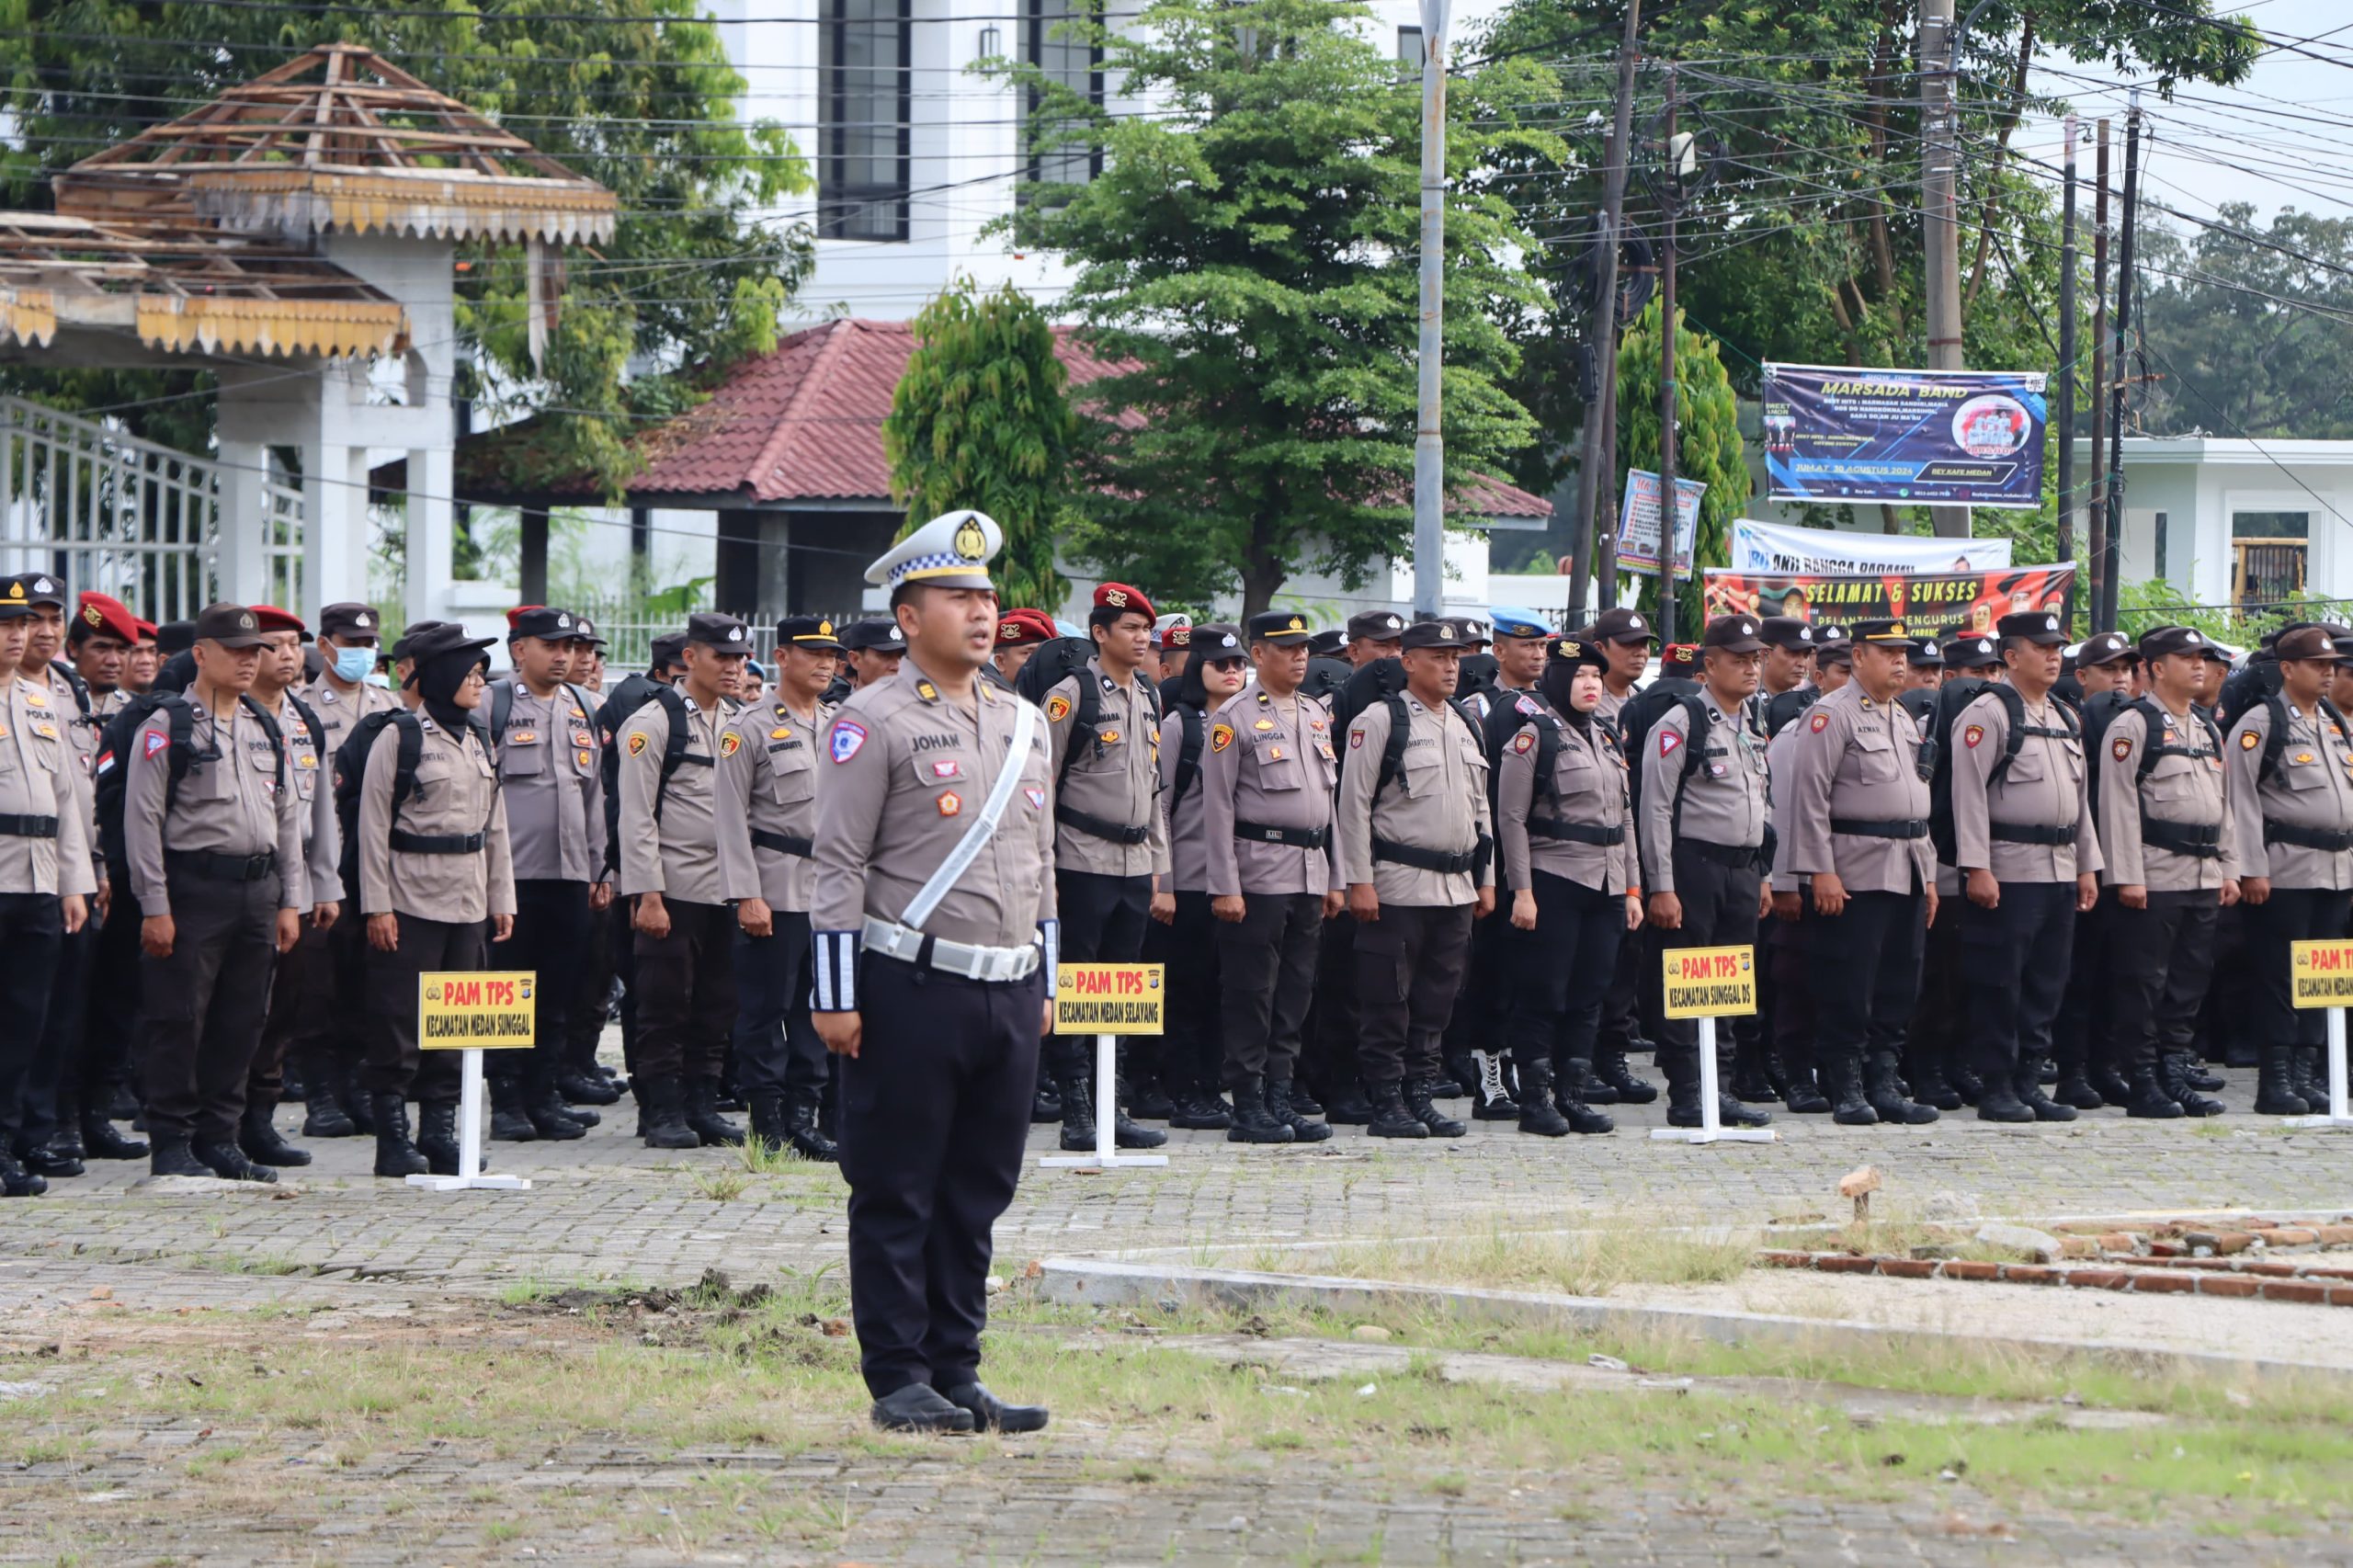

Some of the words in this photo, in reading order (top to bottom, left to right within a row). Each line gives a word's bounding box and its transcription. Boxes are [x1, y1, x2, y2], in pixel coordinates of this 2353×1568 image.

[1821, 381, 1910, 397] MARSADA
[1918, 385, 1969, 399] BAND
[1846, 464, 1889, 475] AGUSTUS
[1805, 583, 1883, 603] SELAMAT
[1891, 582, 1904, 603] &
[1911, 581, 1978, 603] SUKSES
[25, 710, 55, 722] POLRI
[568, 718, 590, 729] POL
[248, 741, 274, 751] POL
[291, 736, 313, 746] POL
[911, 733, 961, 753] JOHAN
[1253, 732, 1286, 744] LINGGA
[1682, 956, 1711, 980] PAM
[1714, 954, 1737, 978] TPS
[2311, 949, 2341, 971] PAM
[2344, 948, 2353, 970] T
[1076, 971, 1112, 994] PAM
[1115, 971, 1143, 994] TPS
[2298, 977, 2333, 998] KECAMATAN
[444, 981, 481, 1006] PAM
[485, 981, 515, 1006] TPS
[1669, 985, 1710, 1008] KECAMATAN
[1710, 983, 1741, 1006] SUNGGAL
[1742, 983, 1751, 1004] DS
[1059, 1001, 1099, 1024] KECAMATAN
[1100, 1002, 1124, 1024] MEDAN
[1125, 1002, 1158, 1024] SELAYANG
[426, 1014, 469, 1038] KECAMATAN
[470, 1014, 495, 1037] MEDAN
[497, 1013, 530, 1036] SUNGGAL
